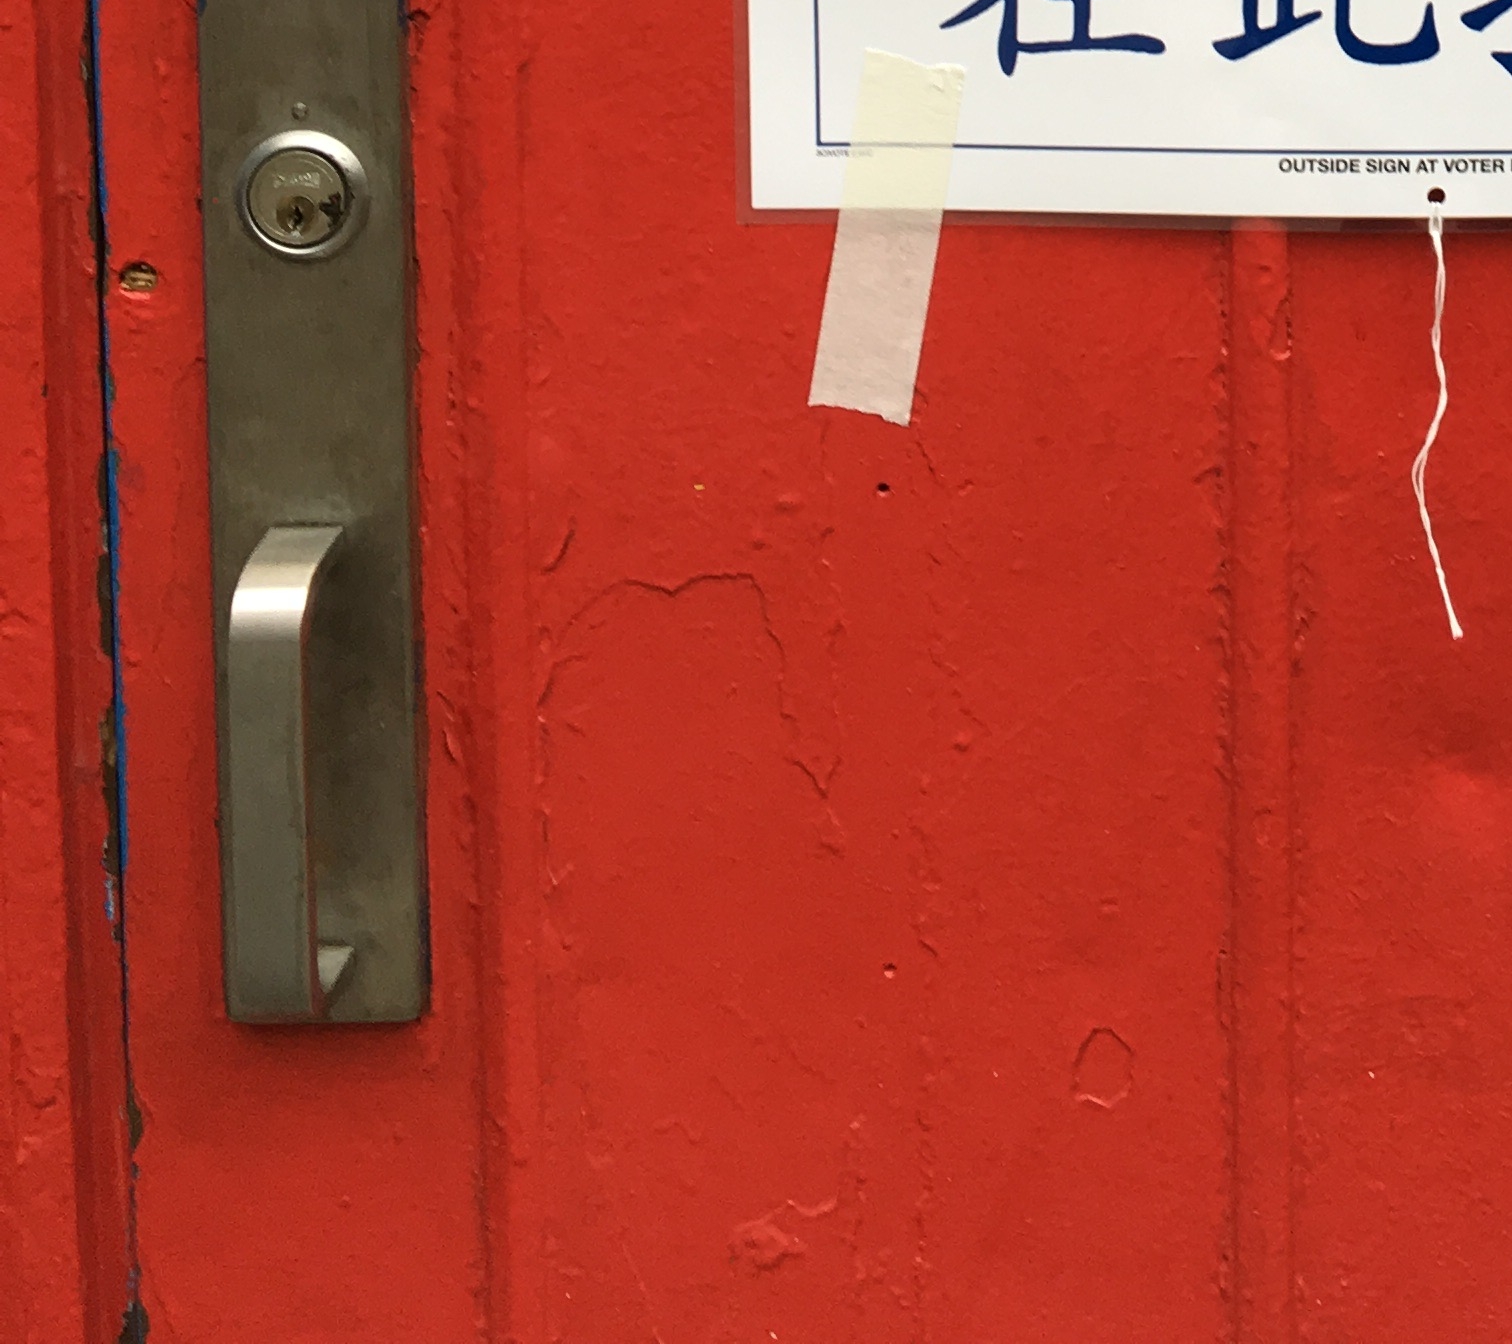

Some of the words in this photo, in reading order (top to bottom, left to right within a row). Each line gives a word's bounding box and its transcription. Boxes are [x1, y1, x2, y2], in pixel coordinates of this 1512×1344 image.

[1278, 158, 1360, 173] OUTSIDE
[1365, 158, 1411, 173] SIGN
[1416, 158, 1438, 173] AT
[1443, 158, 1505, 173] VOTER
